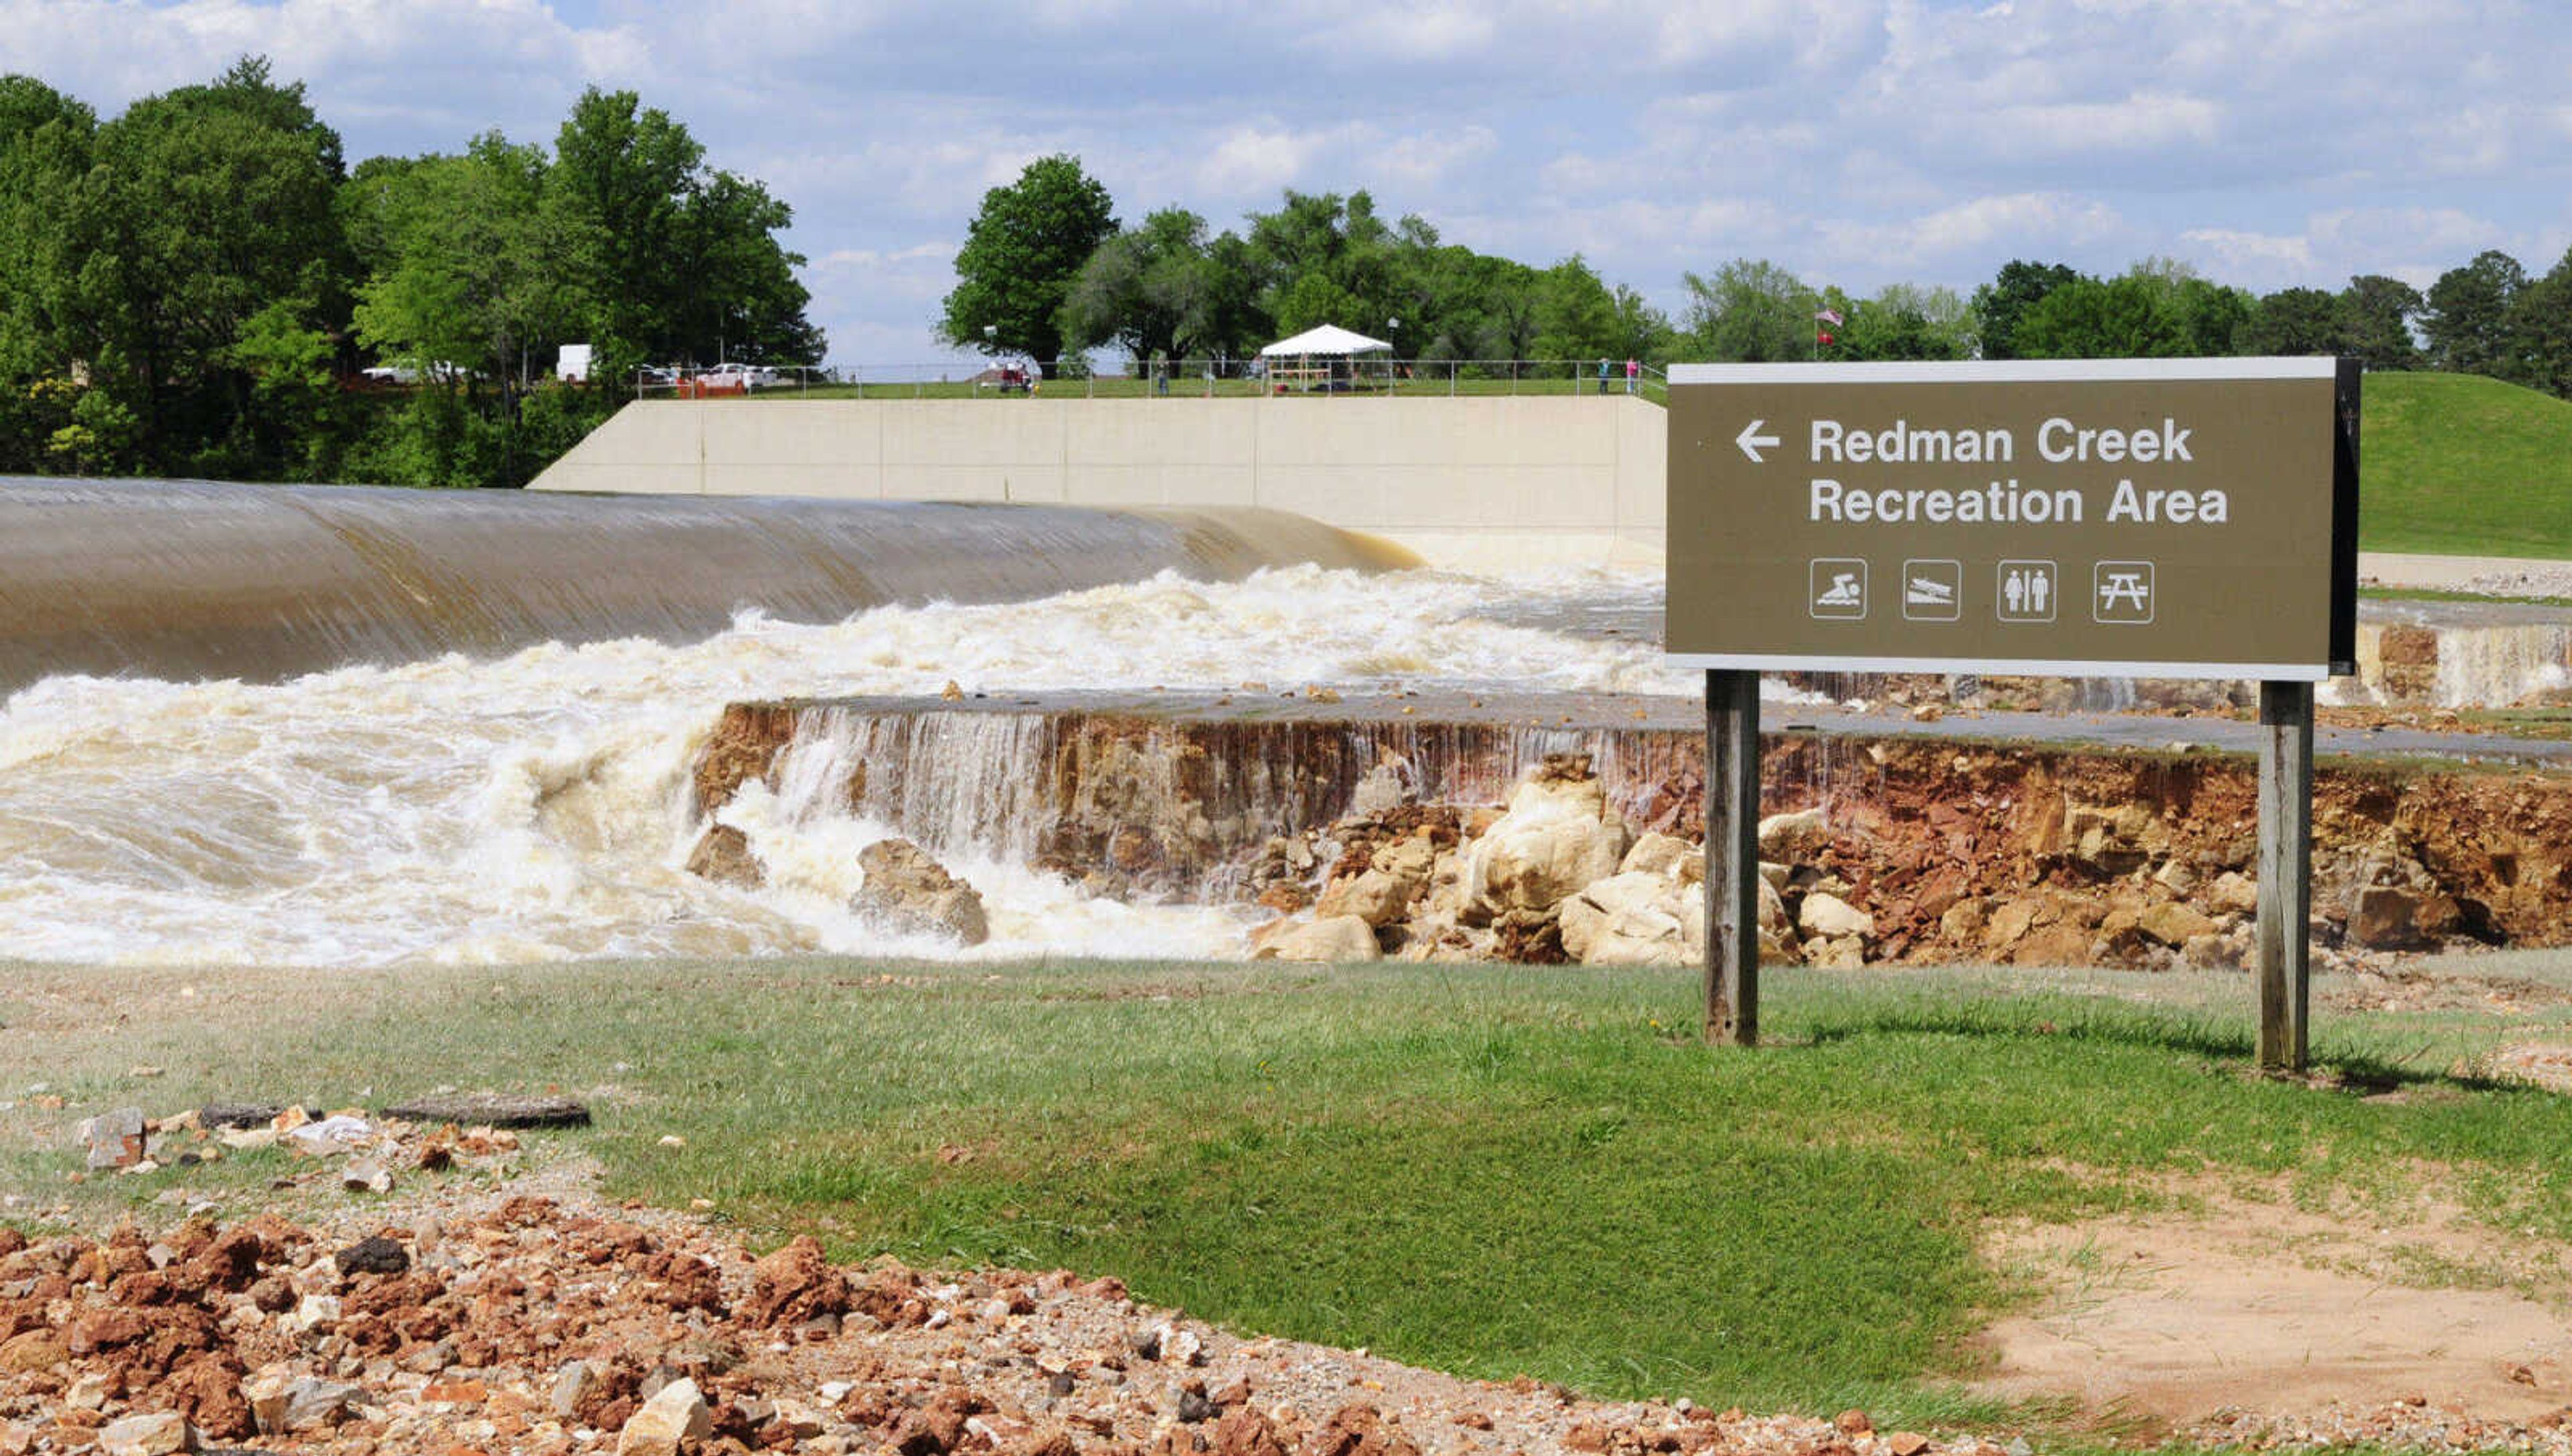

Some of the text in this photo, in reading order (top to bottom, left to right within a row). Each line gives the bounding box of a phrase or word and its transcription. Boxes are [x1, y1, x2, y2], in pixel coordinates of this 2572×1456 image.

[1811, 417, 2193, 462] Redman Creek
[1810, 479, 2227, 523] Recreation Area
